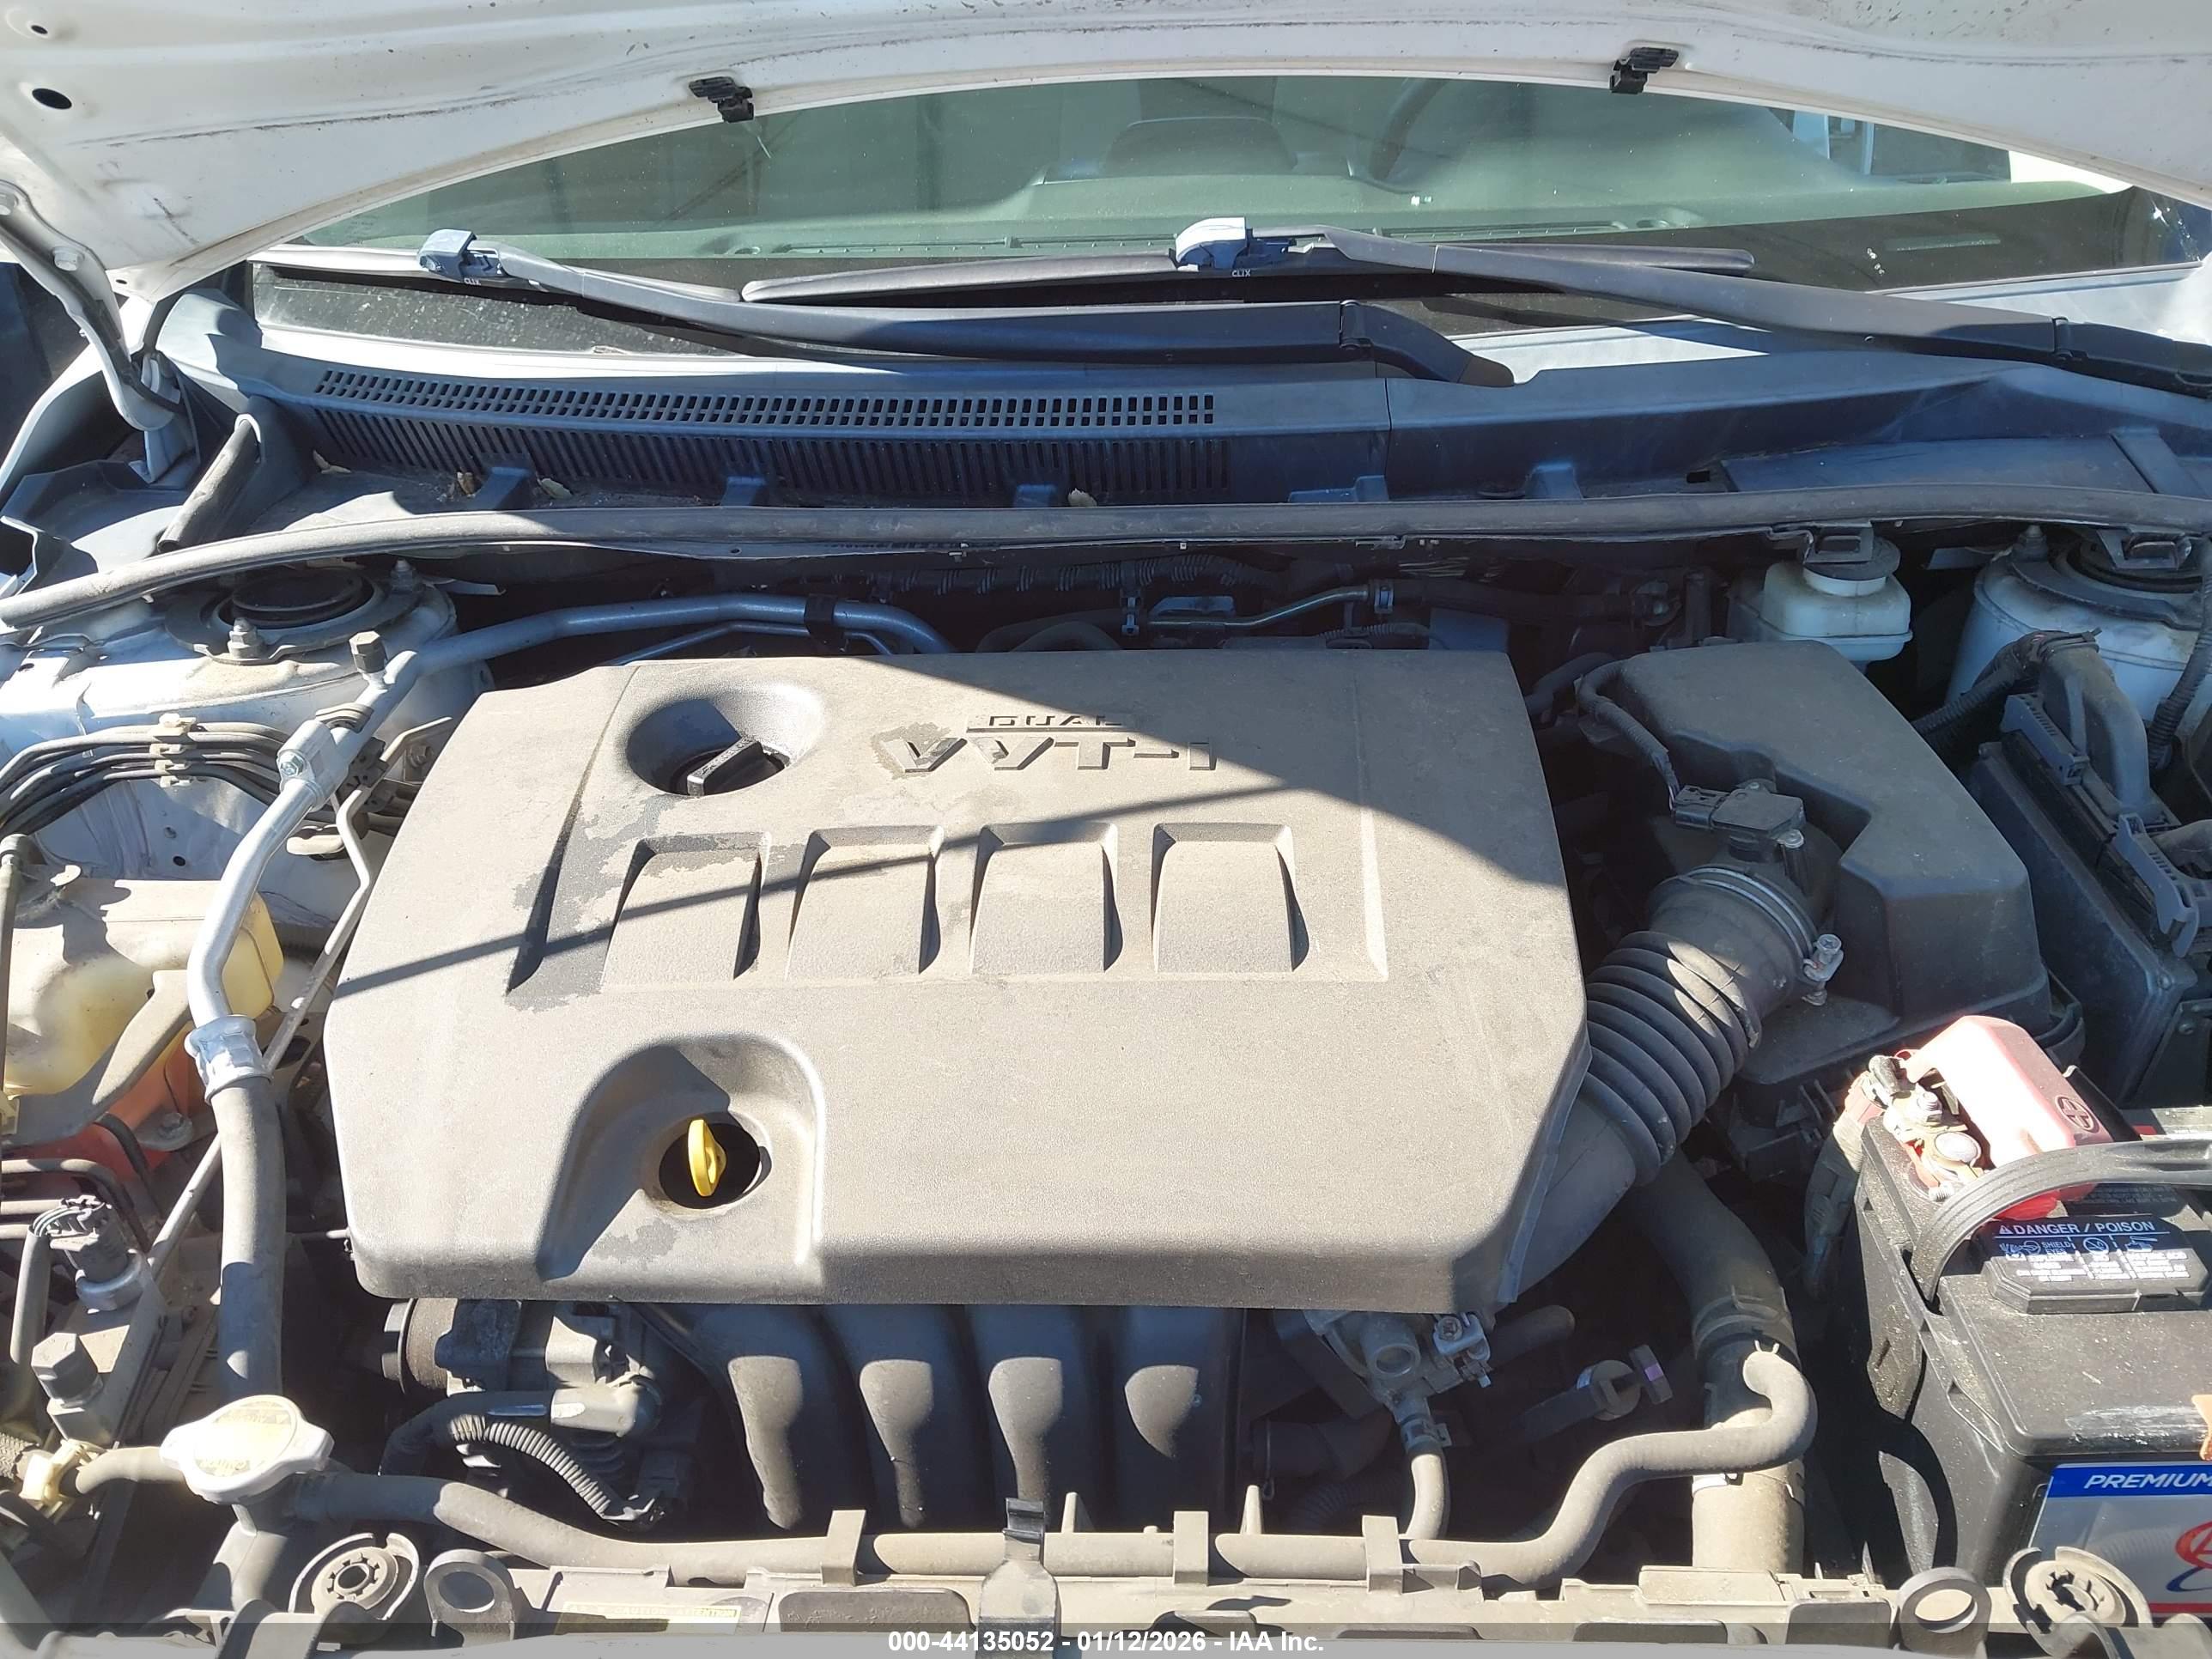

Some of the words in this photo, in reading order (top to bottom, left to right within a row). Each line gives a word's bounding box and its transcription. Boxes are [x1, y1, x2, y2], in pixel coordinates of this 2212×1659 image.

[1231, 269, 1251, 277] CLIX
[988, 714, 1123, 726] DUAL
[2014, 1224, 2081, 1235] DANGER
[2097, 1221, 2156, 1233] POISON
[2084, 1473, 2212, 1489] PREMIUM
